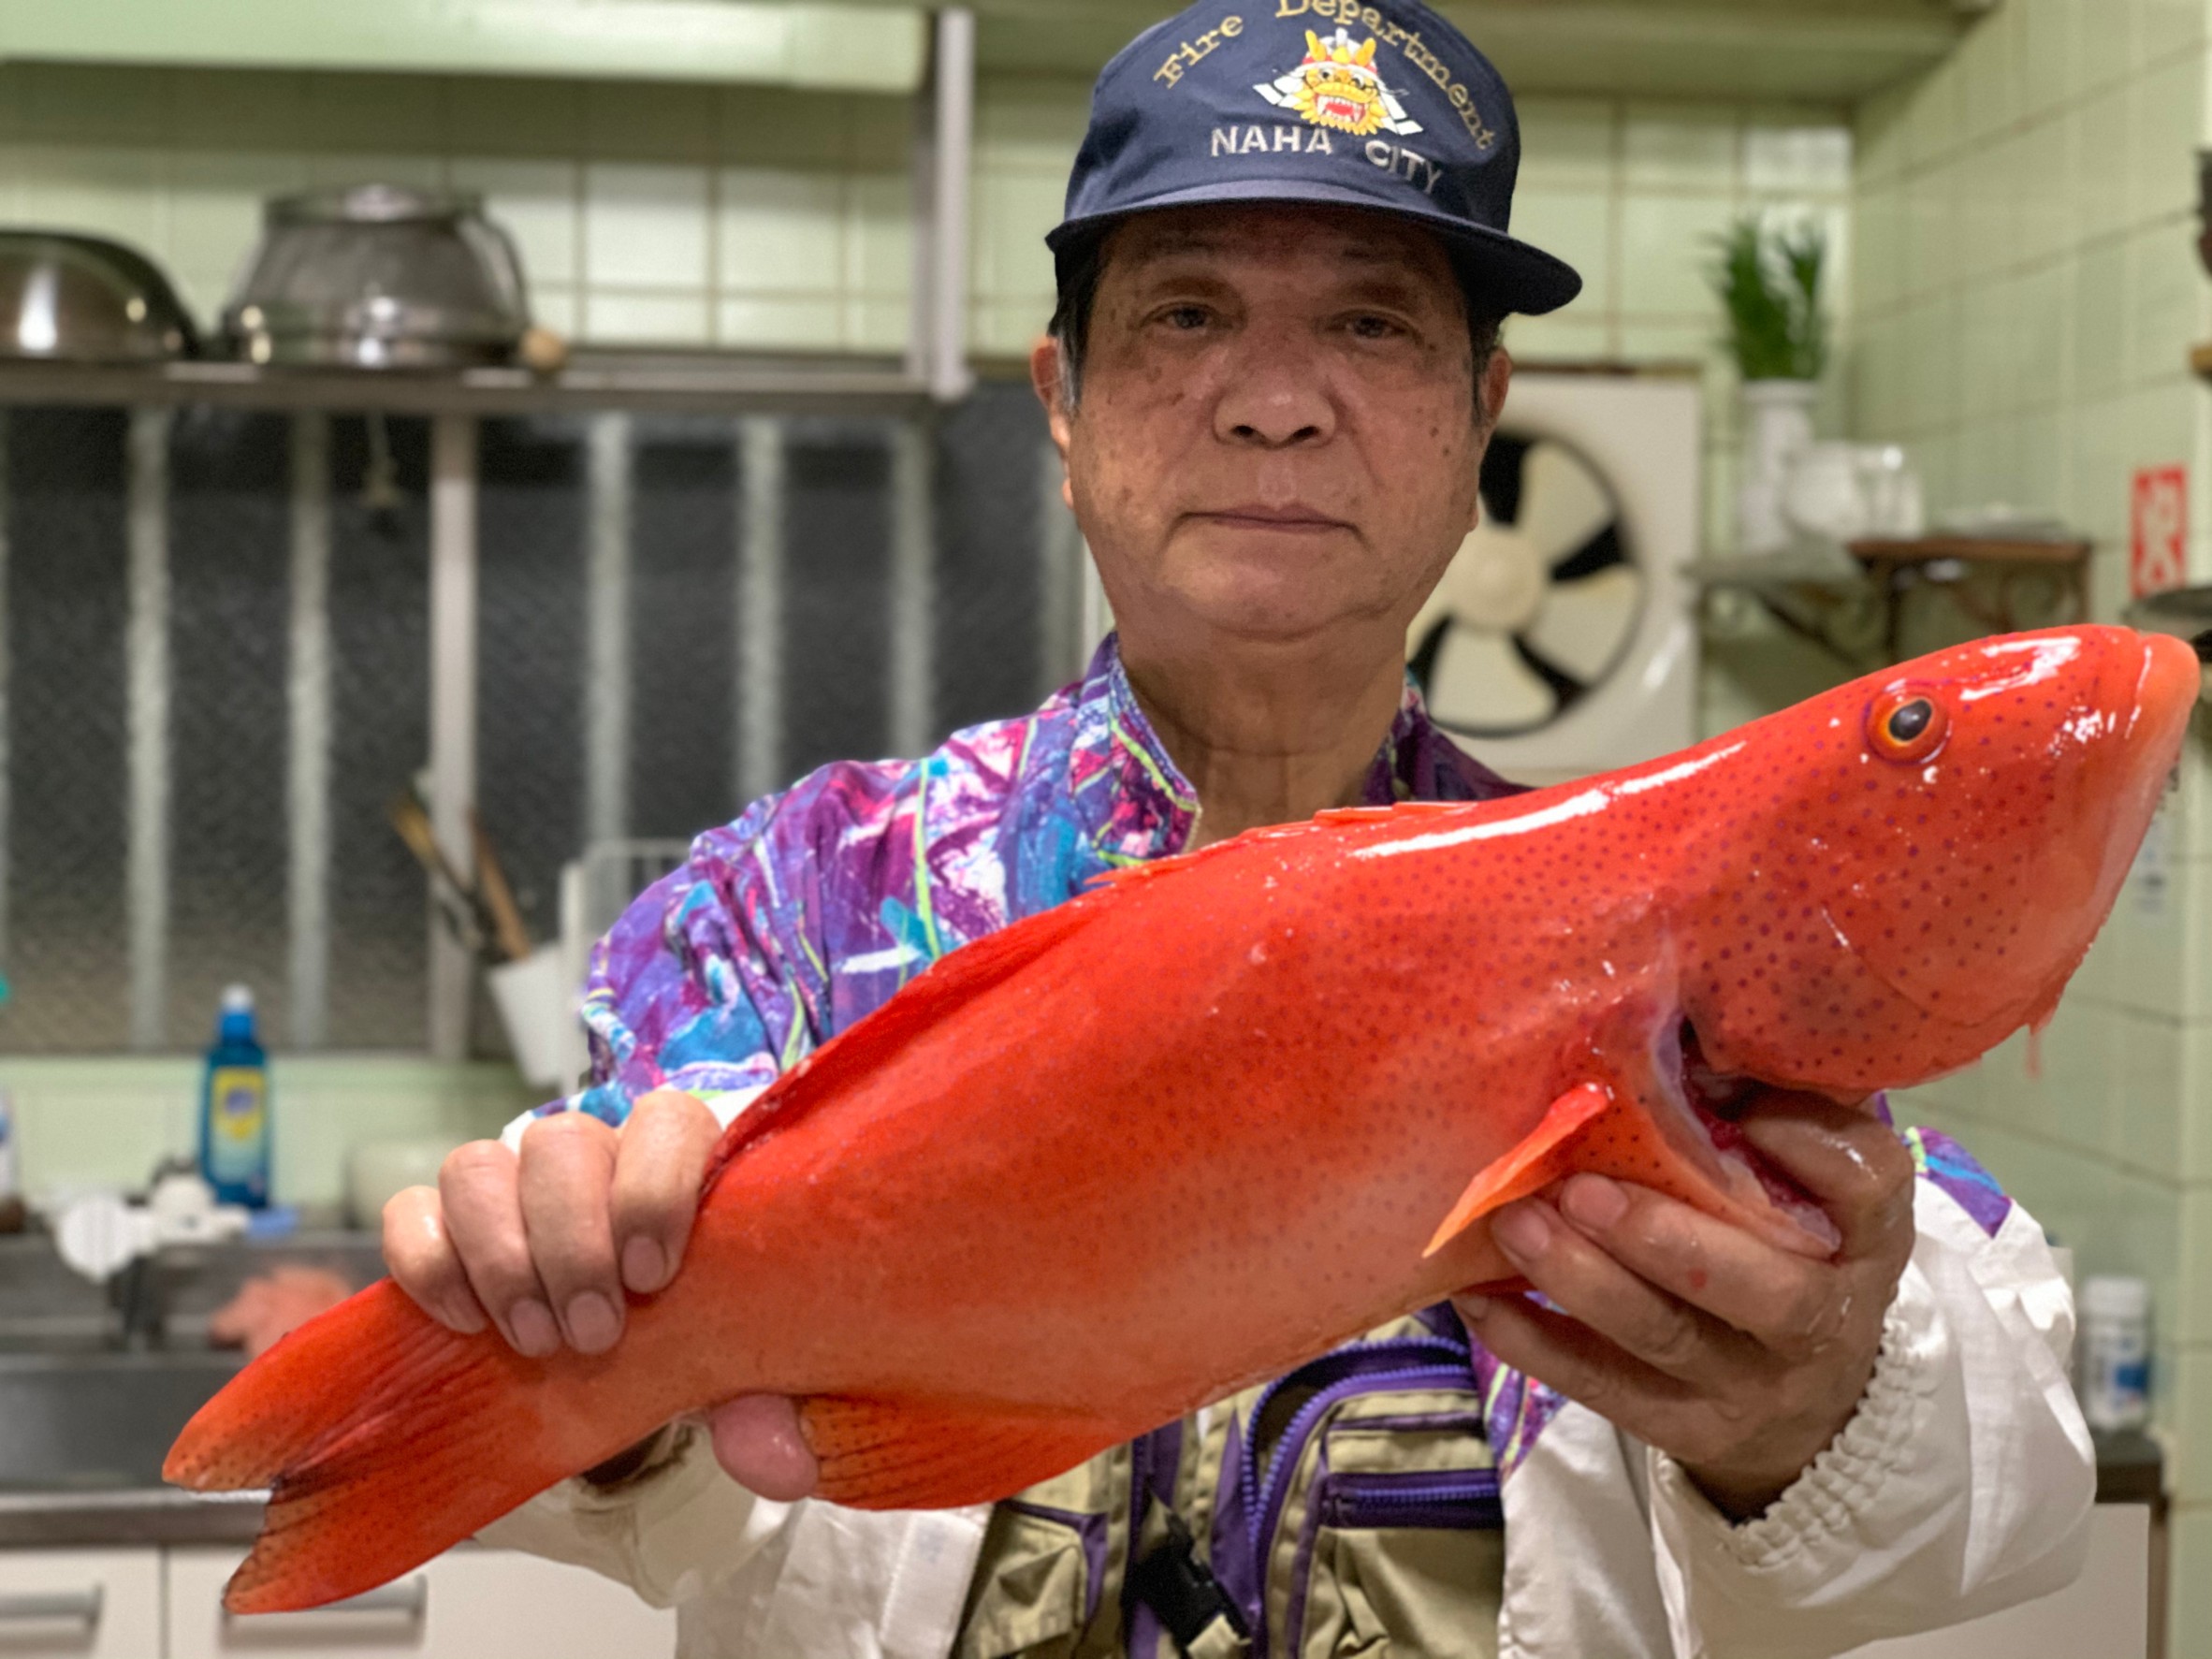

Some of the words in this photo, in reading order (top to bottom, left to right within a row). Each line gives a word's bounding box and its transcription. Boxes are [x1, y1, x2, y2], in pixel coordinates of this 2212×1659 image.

[1153, 15, 1244, 89] Fire
[1275, 0, 1495, 150] Department
[1211, 125, 1332, 156] NAHA
[1365, 139, 1443, 195] CITY
